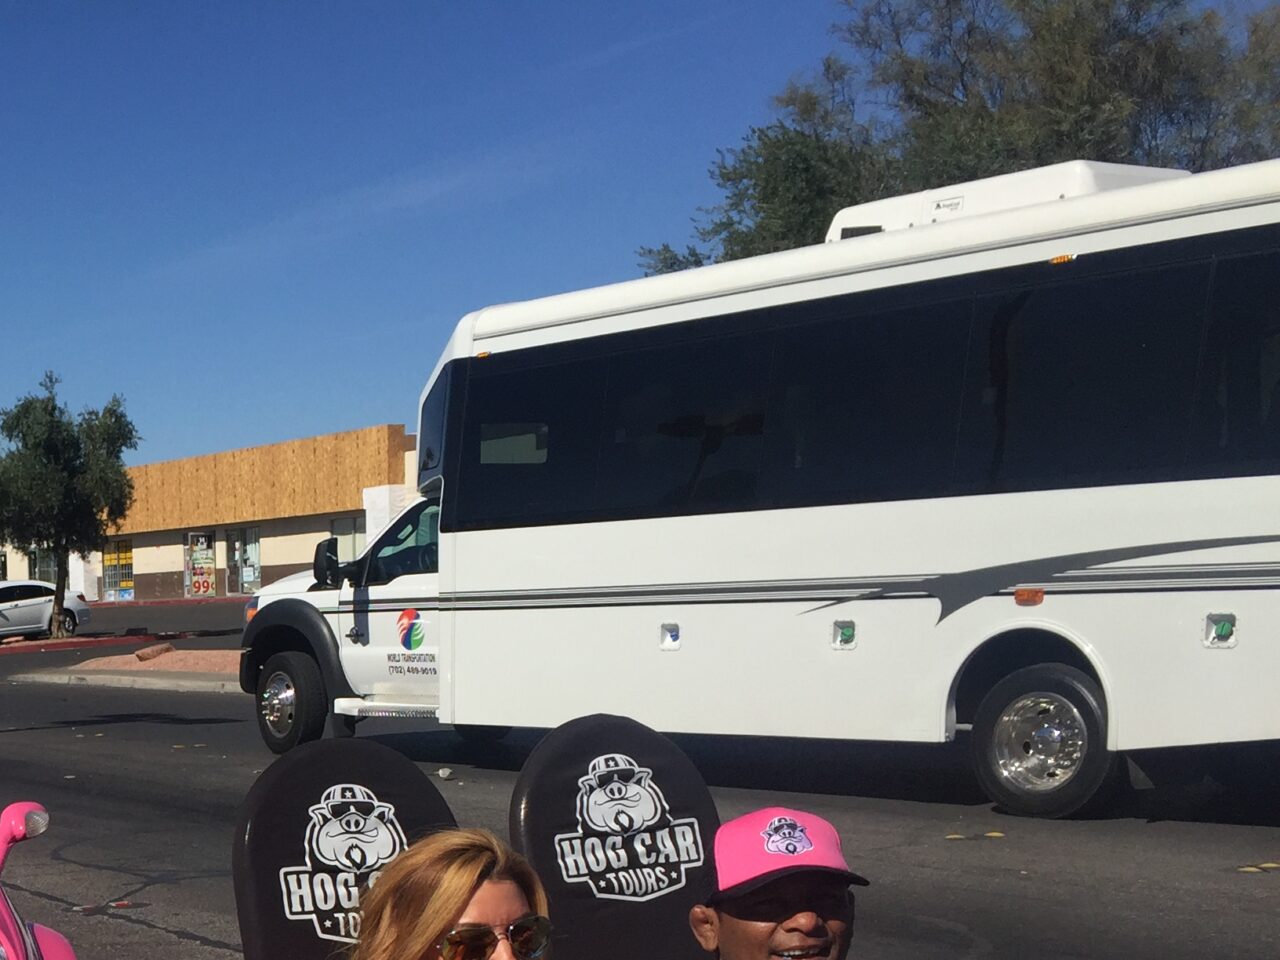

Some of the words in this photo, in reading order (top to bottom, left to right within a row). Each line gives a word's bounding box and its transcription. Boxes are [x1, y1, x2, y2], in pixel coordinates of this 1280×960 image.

[388, 666, 406, 676] (702)
[561, 835, 628, 875] HOG
[633, 825, 698, 865] CAR
[288, 872, 359, 912] HOG
[605, 866, 669, 896] TOURS
